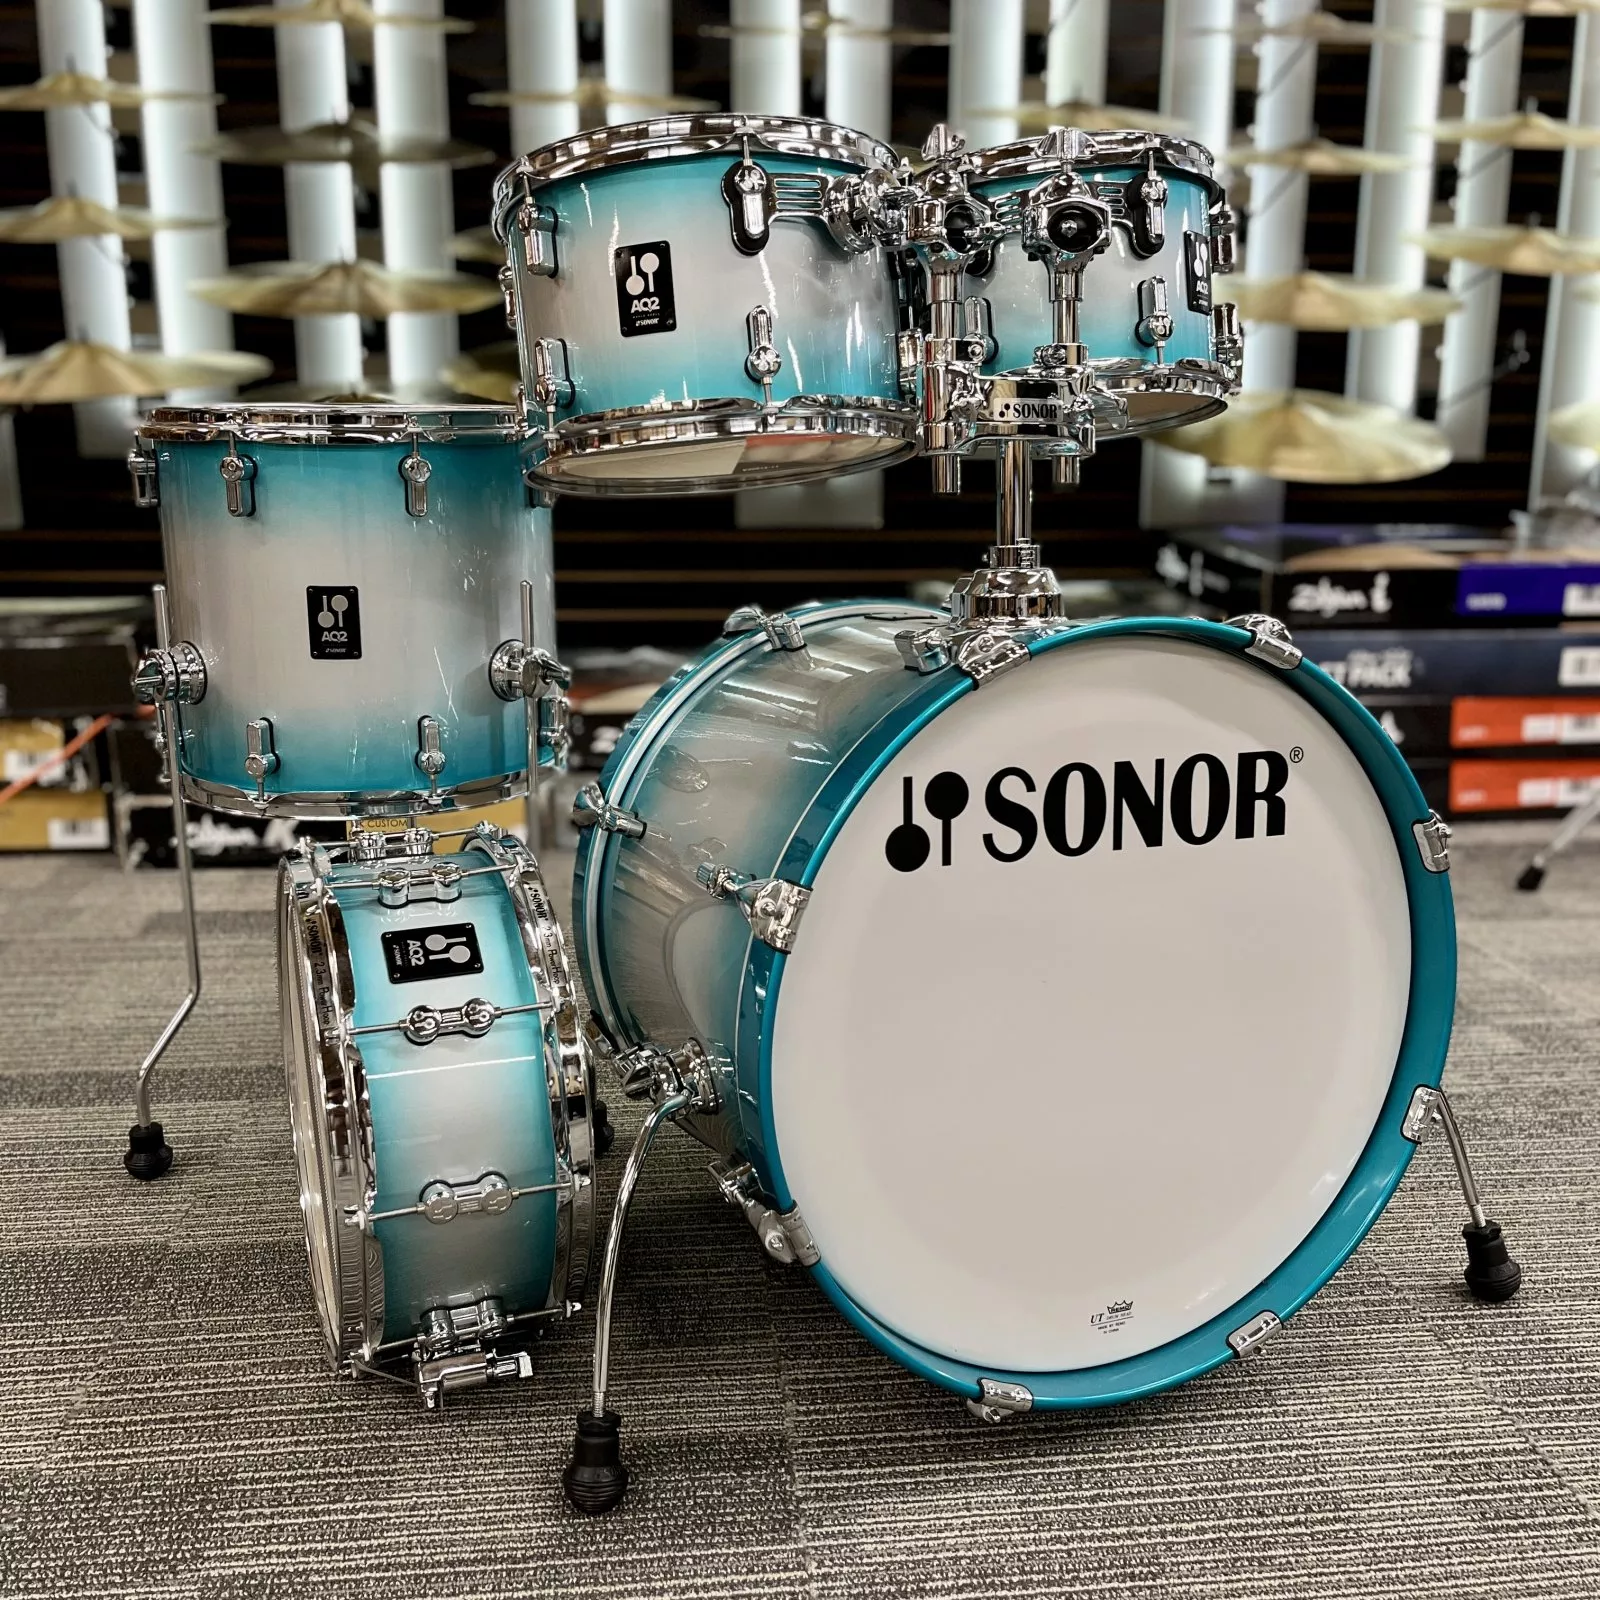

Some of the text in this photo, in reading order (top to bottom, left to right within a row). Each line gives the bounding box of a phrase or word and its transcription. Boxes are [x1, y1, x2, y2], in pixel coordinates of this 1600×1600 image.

[631, 296, 660, 313] AQ2
[1013, 403, 1058, 419] SONOR
[322, 631, 348, 643] AQ2
[367, 818, 408, 828] CUSTOM
[406, 939, 425, 967] AQ2
[1090, 1312, 1105, 1324] UT
